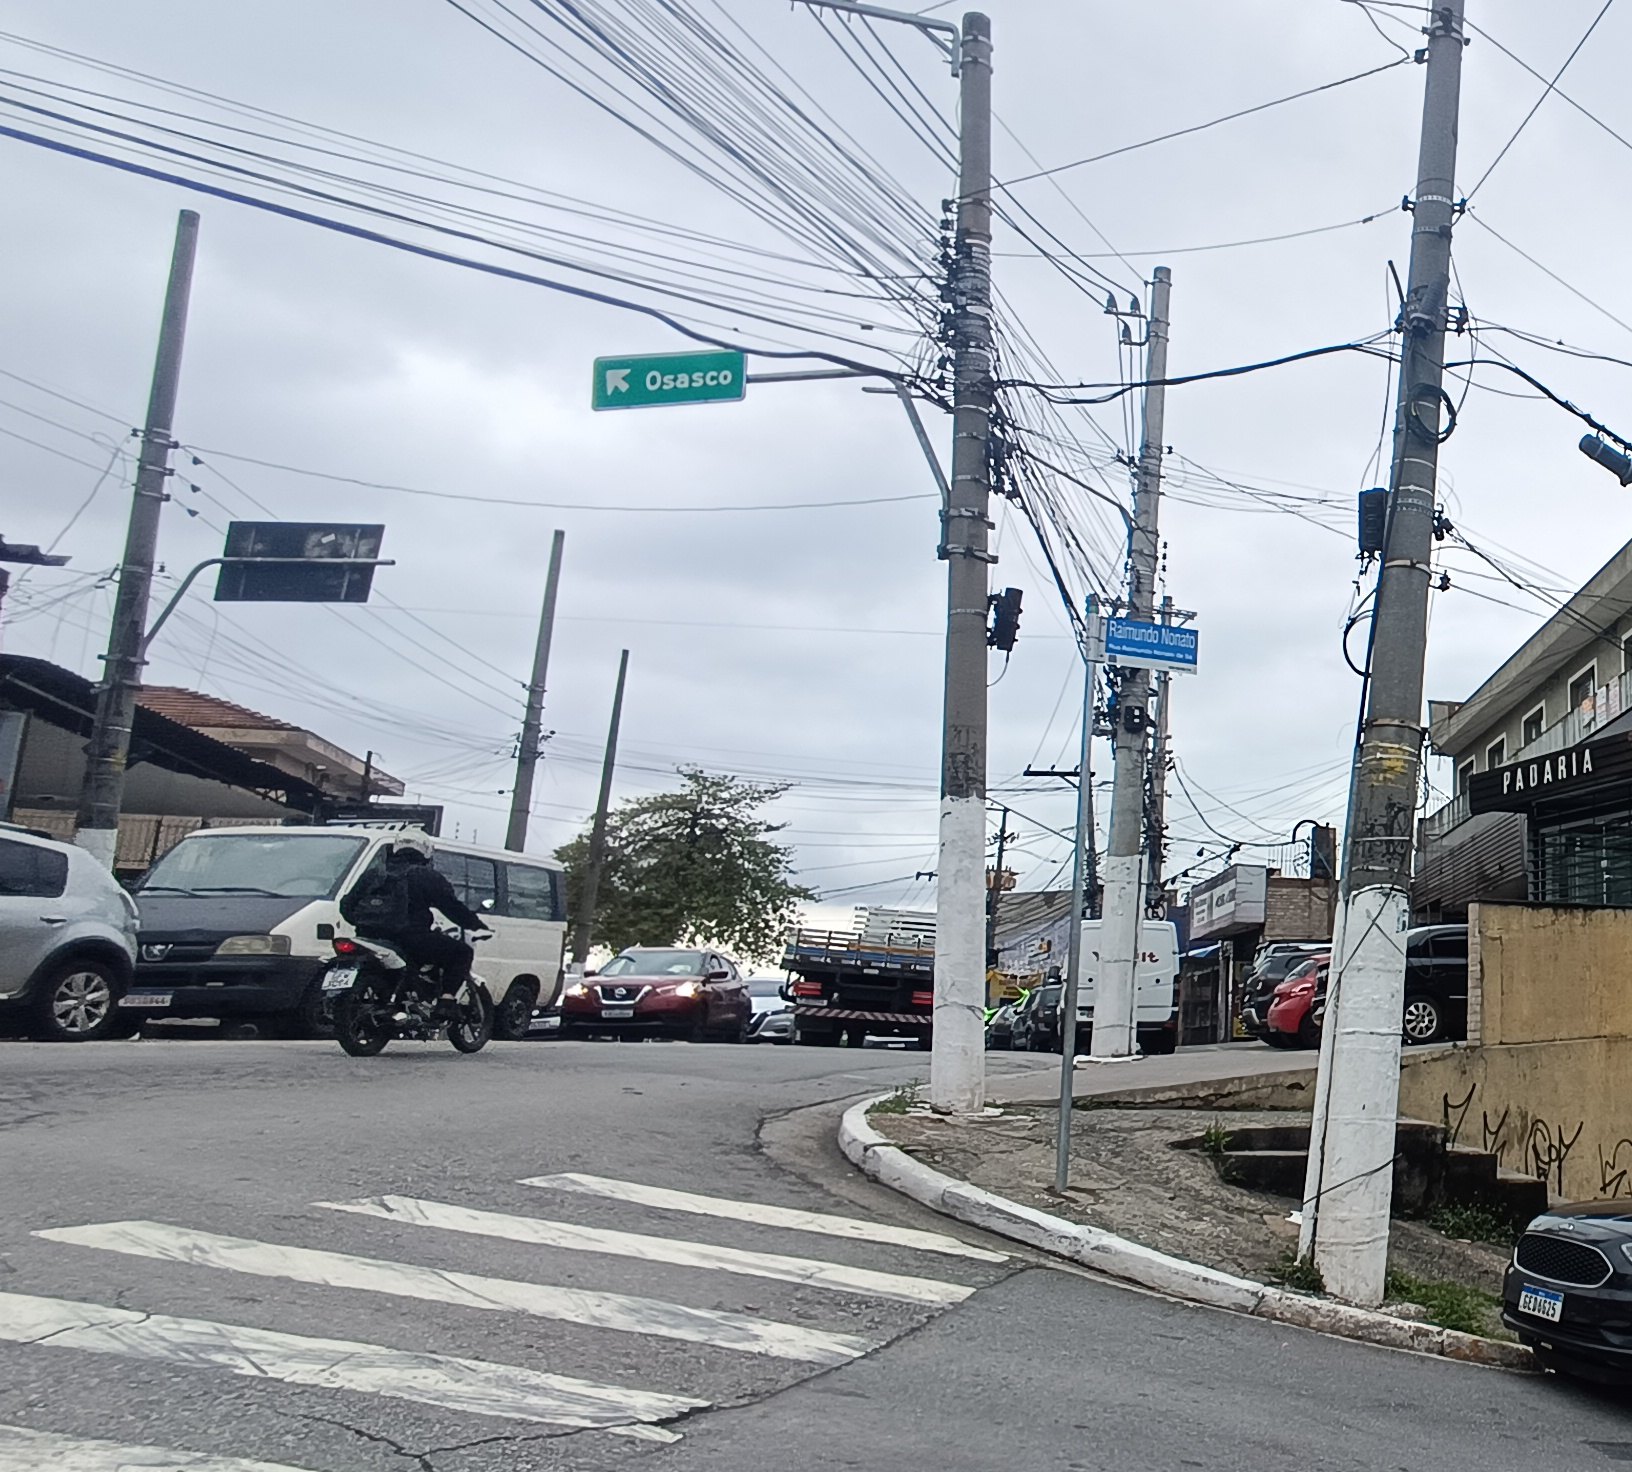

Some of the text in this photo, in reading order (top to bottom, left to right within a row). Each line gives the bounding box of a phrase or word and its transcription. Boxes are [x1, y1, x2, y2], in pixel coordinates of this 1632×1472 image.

[645, 370, 732, 391] Osasco
[1108, 620, 1195, 649] Raimundo Nonato
[1503, 749, 1593, 795] PADARIA
